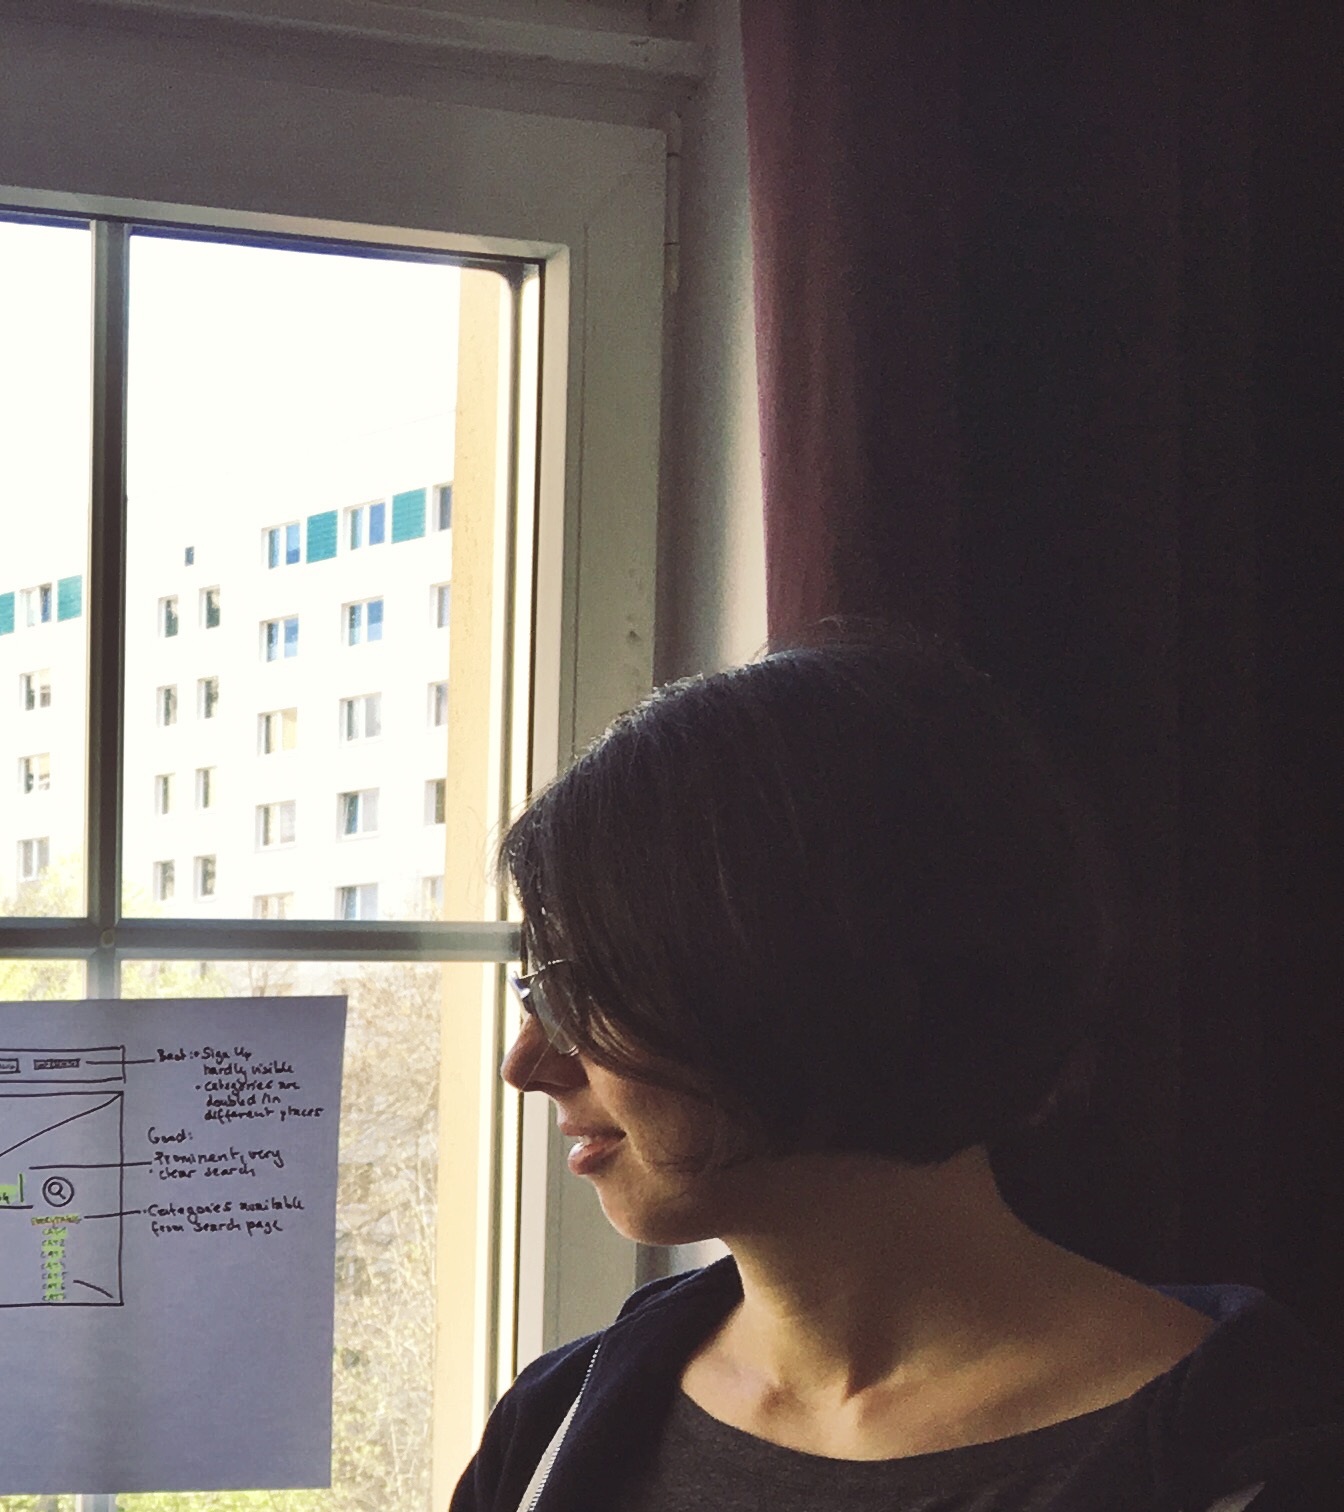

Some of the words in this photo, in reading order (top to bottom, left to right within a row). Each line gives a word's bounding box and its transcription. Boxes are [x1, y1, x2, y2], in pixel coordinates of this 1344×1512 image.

[252, 1061, 294, 1074] visible
[204, 1107, 274, 1125] different
[280, 1105, 324, 1121] places
[248, 1149, 285, 1168] very
[204, 1166, 256, 1177] search
[151, 1222, 184, 1237] from
[246, 1219, 284, 1237] page
